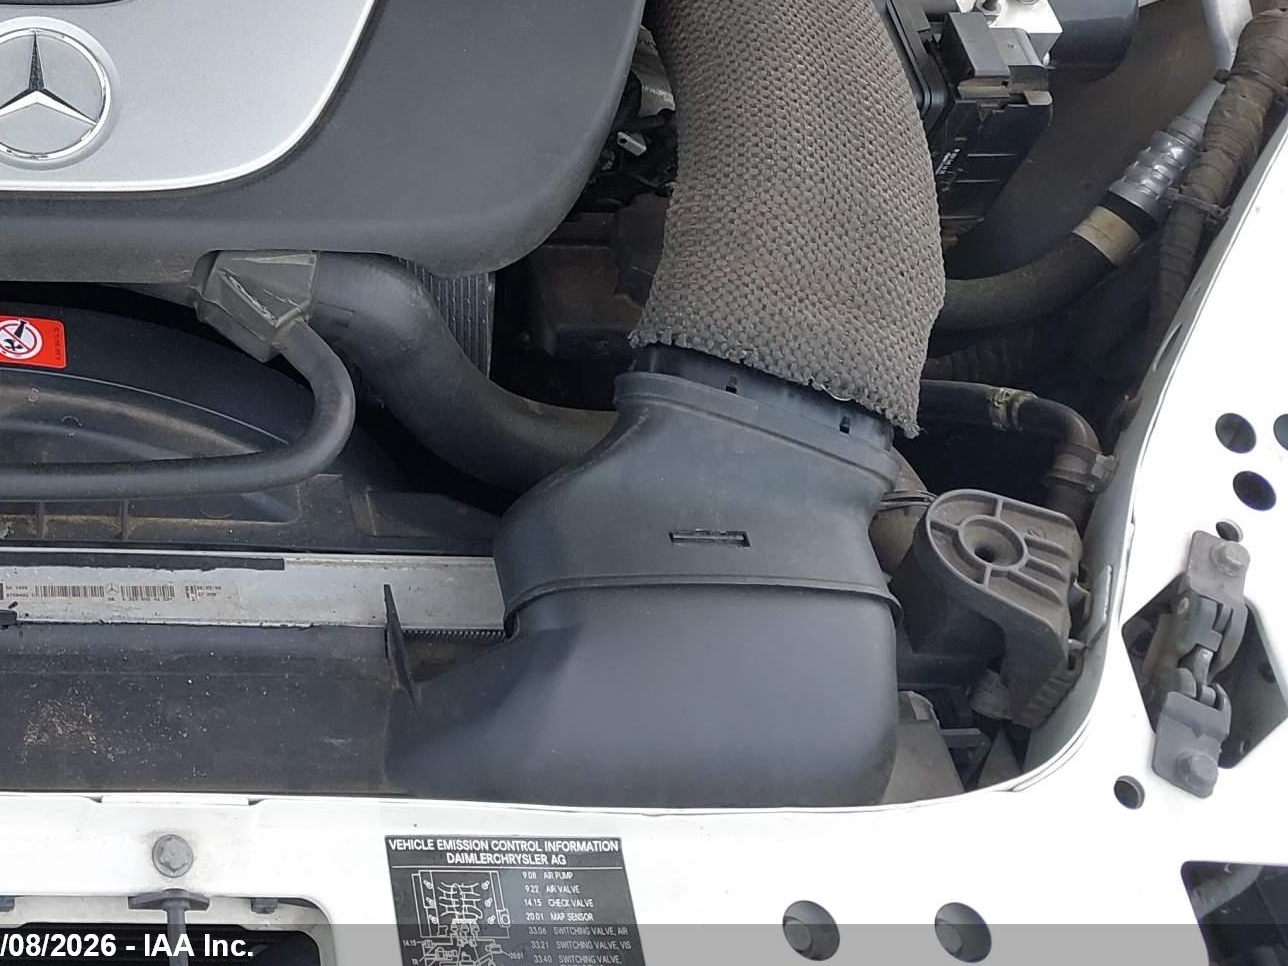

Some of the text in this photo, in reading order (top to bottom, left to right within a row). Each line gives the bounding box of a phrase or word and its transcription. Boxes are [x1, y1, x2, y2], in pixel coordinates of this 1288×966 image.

[388, 839, 619, 852] VEHICLE EMISSION CONTROL INFORMATION
[446, 852, 567, 865] DAIMLERCHRYSLER AG
[544, 872, 554, 880] AIR
[555, 872, 574, 880] PUMP
[546, 885, 557, 894] AIR
[558, 885, 580, 894] VALVE
[548, 898, 570, 907] CHECK
[570, 898, 594, 908] VALVE
[550, 912, 566, 921] MAP
[567, 912, 594, 922] SENSOR
[554, 926, 592, 934] SWITCHING
[618, 927, 628, 935] AIR
[556, 941, 593, 949] SWITCHING
[620, 941, 632, 950] VIS
[558, 955, 597, 964] SWITCHING
